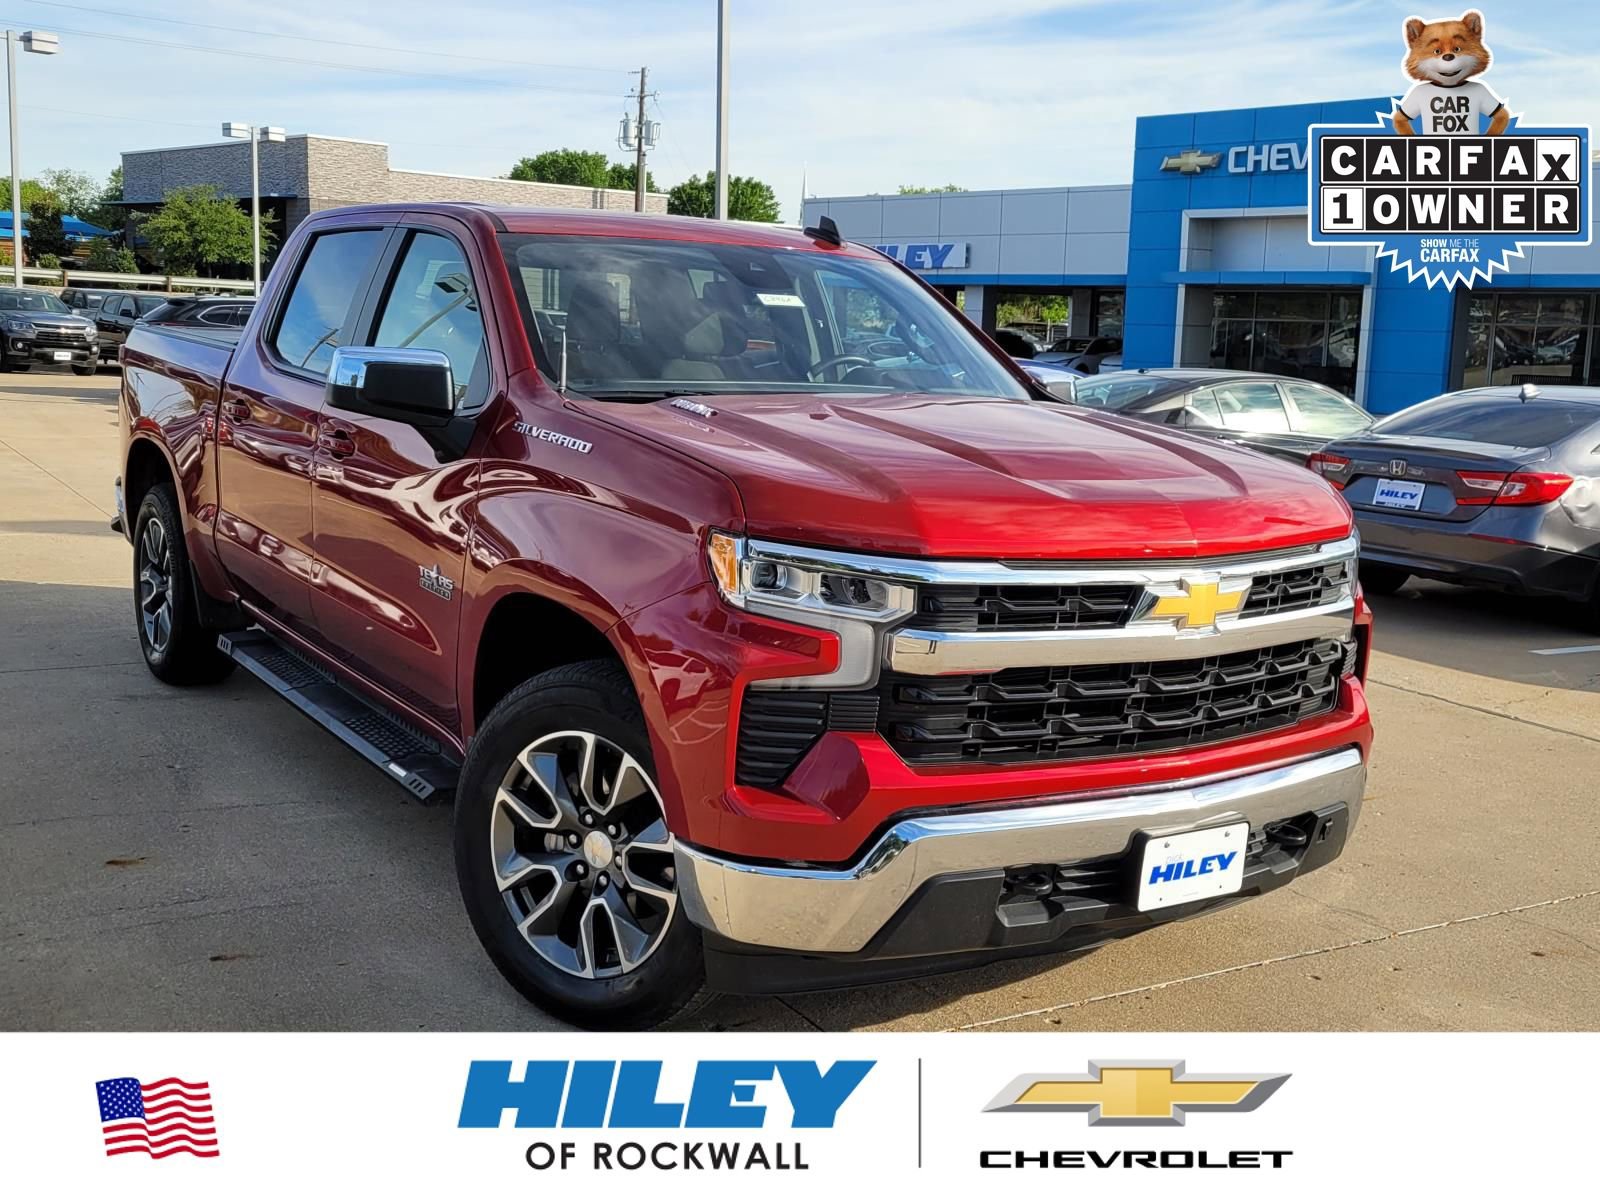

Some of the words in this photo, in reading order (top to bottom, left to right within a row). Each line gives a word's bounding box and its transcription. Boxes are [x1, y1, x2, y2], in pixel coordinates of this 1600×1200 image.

[512, 421, 593, 454] SILVERADO
[1380, 489, 1418, 500] HILEY
[1148, 851, 1238, 885] HILEY
